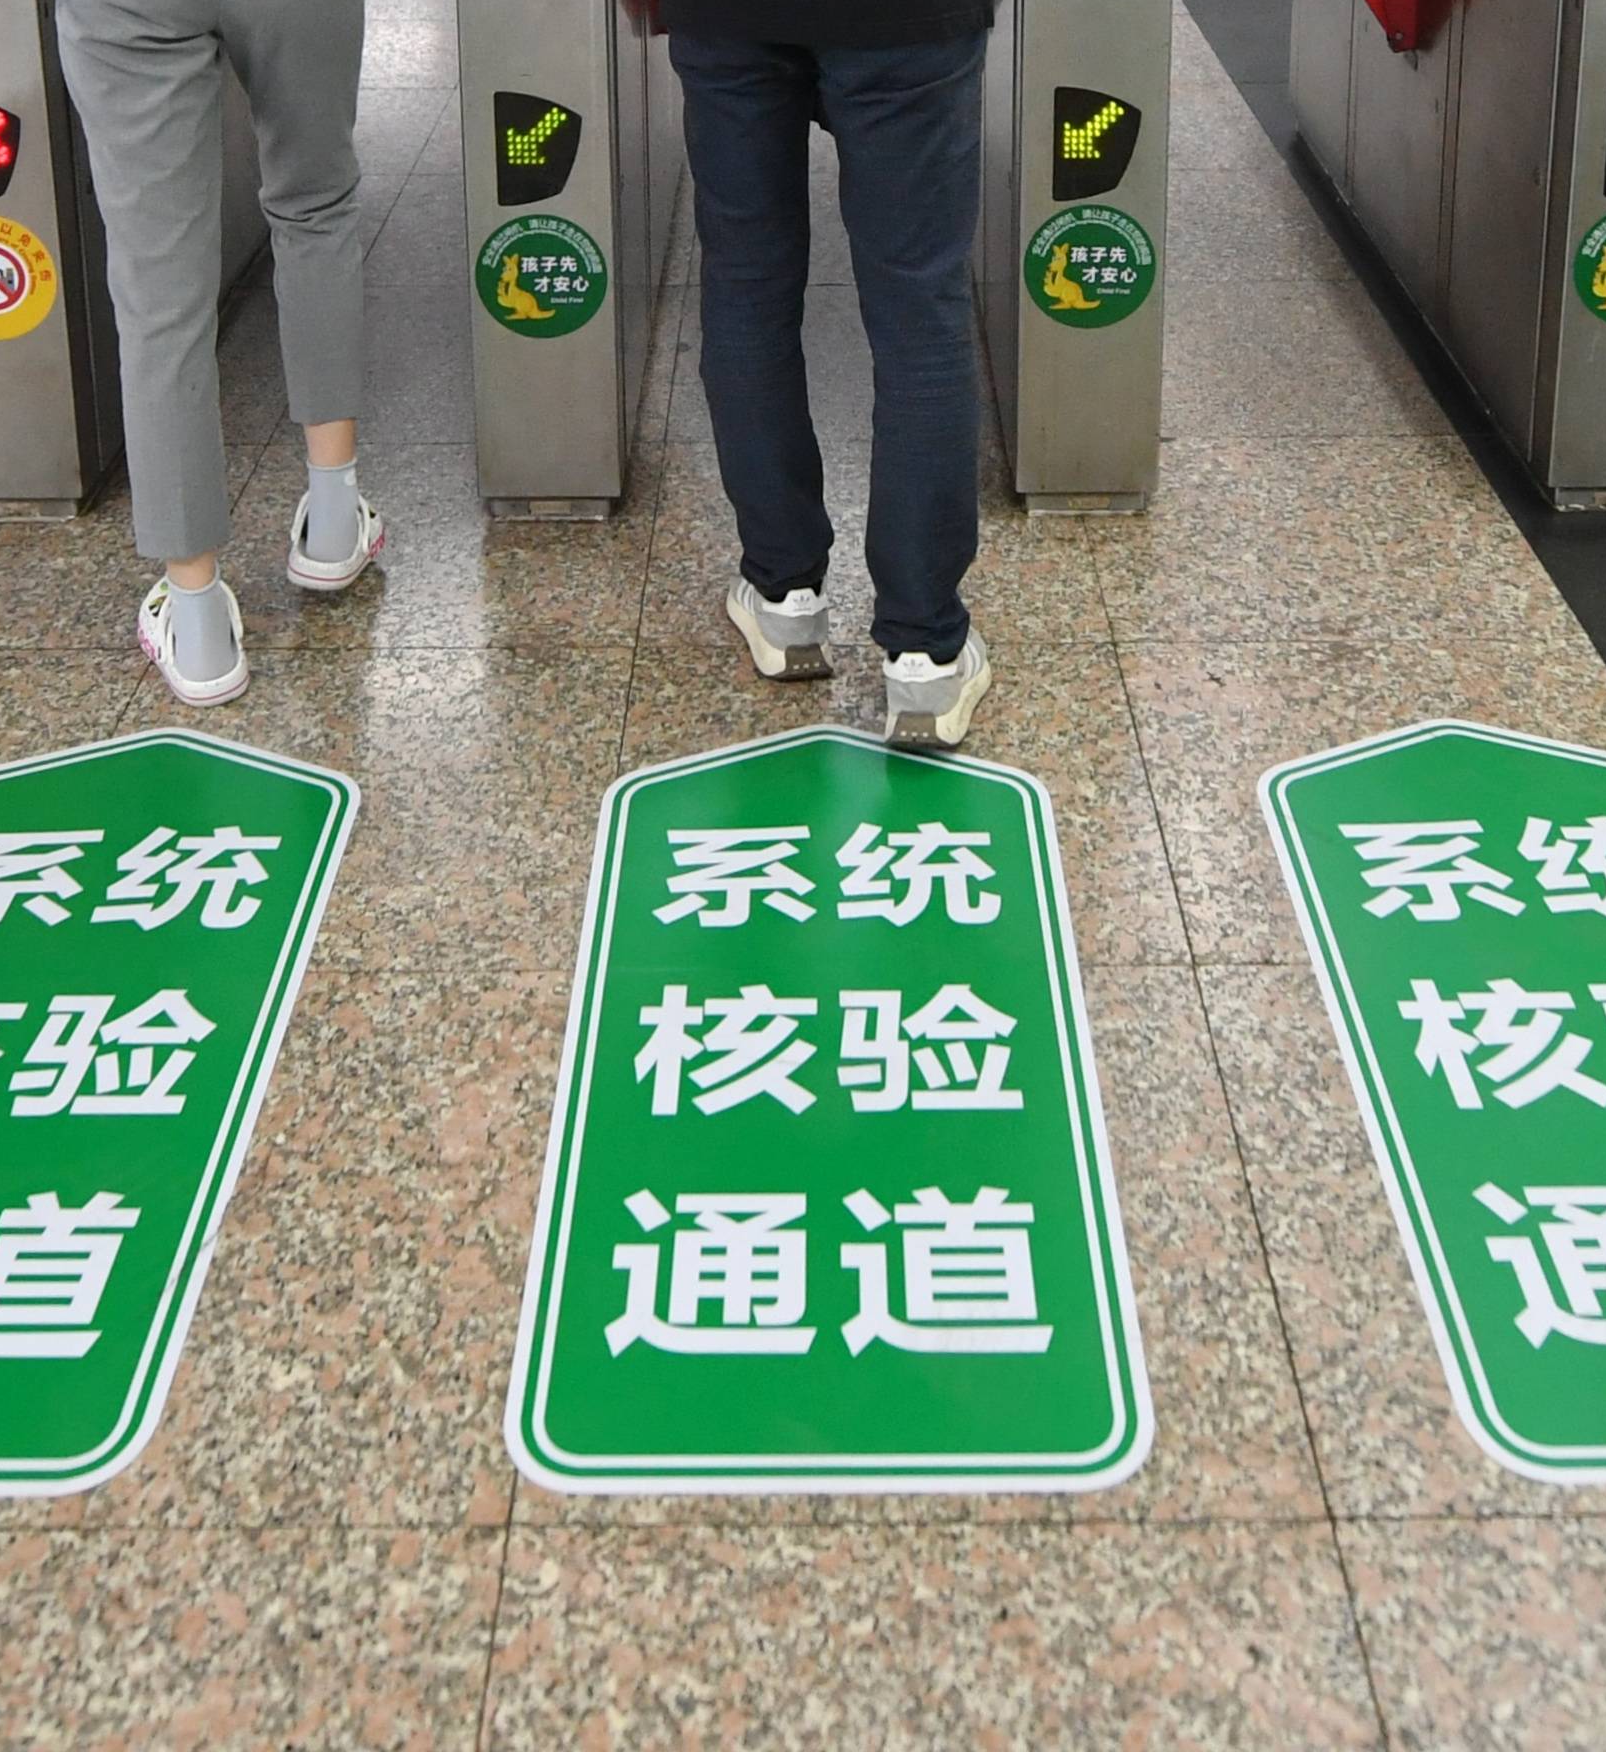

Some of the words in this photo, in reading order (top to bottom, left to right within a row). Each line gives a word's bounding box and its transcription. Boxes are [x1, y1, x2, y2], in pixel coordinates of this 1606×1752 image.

[1070, 246, 1126, 263] 孩子先
[521, 256, 577, 273] 孩子先
[533, 275, 589, 293] 才安心
[1081, 267, 1137, 283] 才安心
[652, 822, 1001, 928] 系统
[634, 984, 1024, 1116] 核验
[604, 1186, 1054, 1358] 通道
